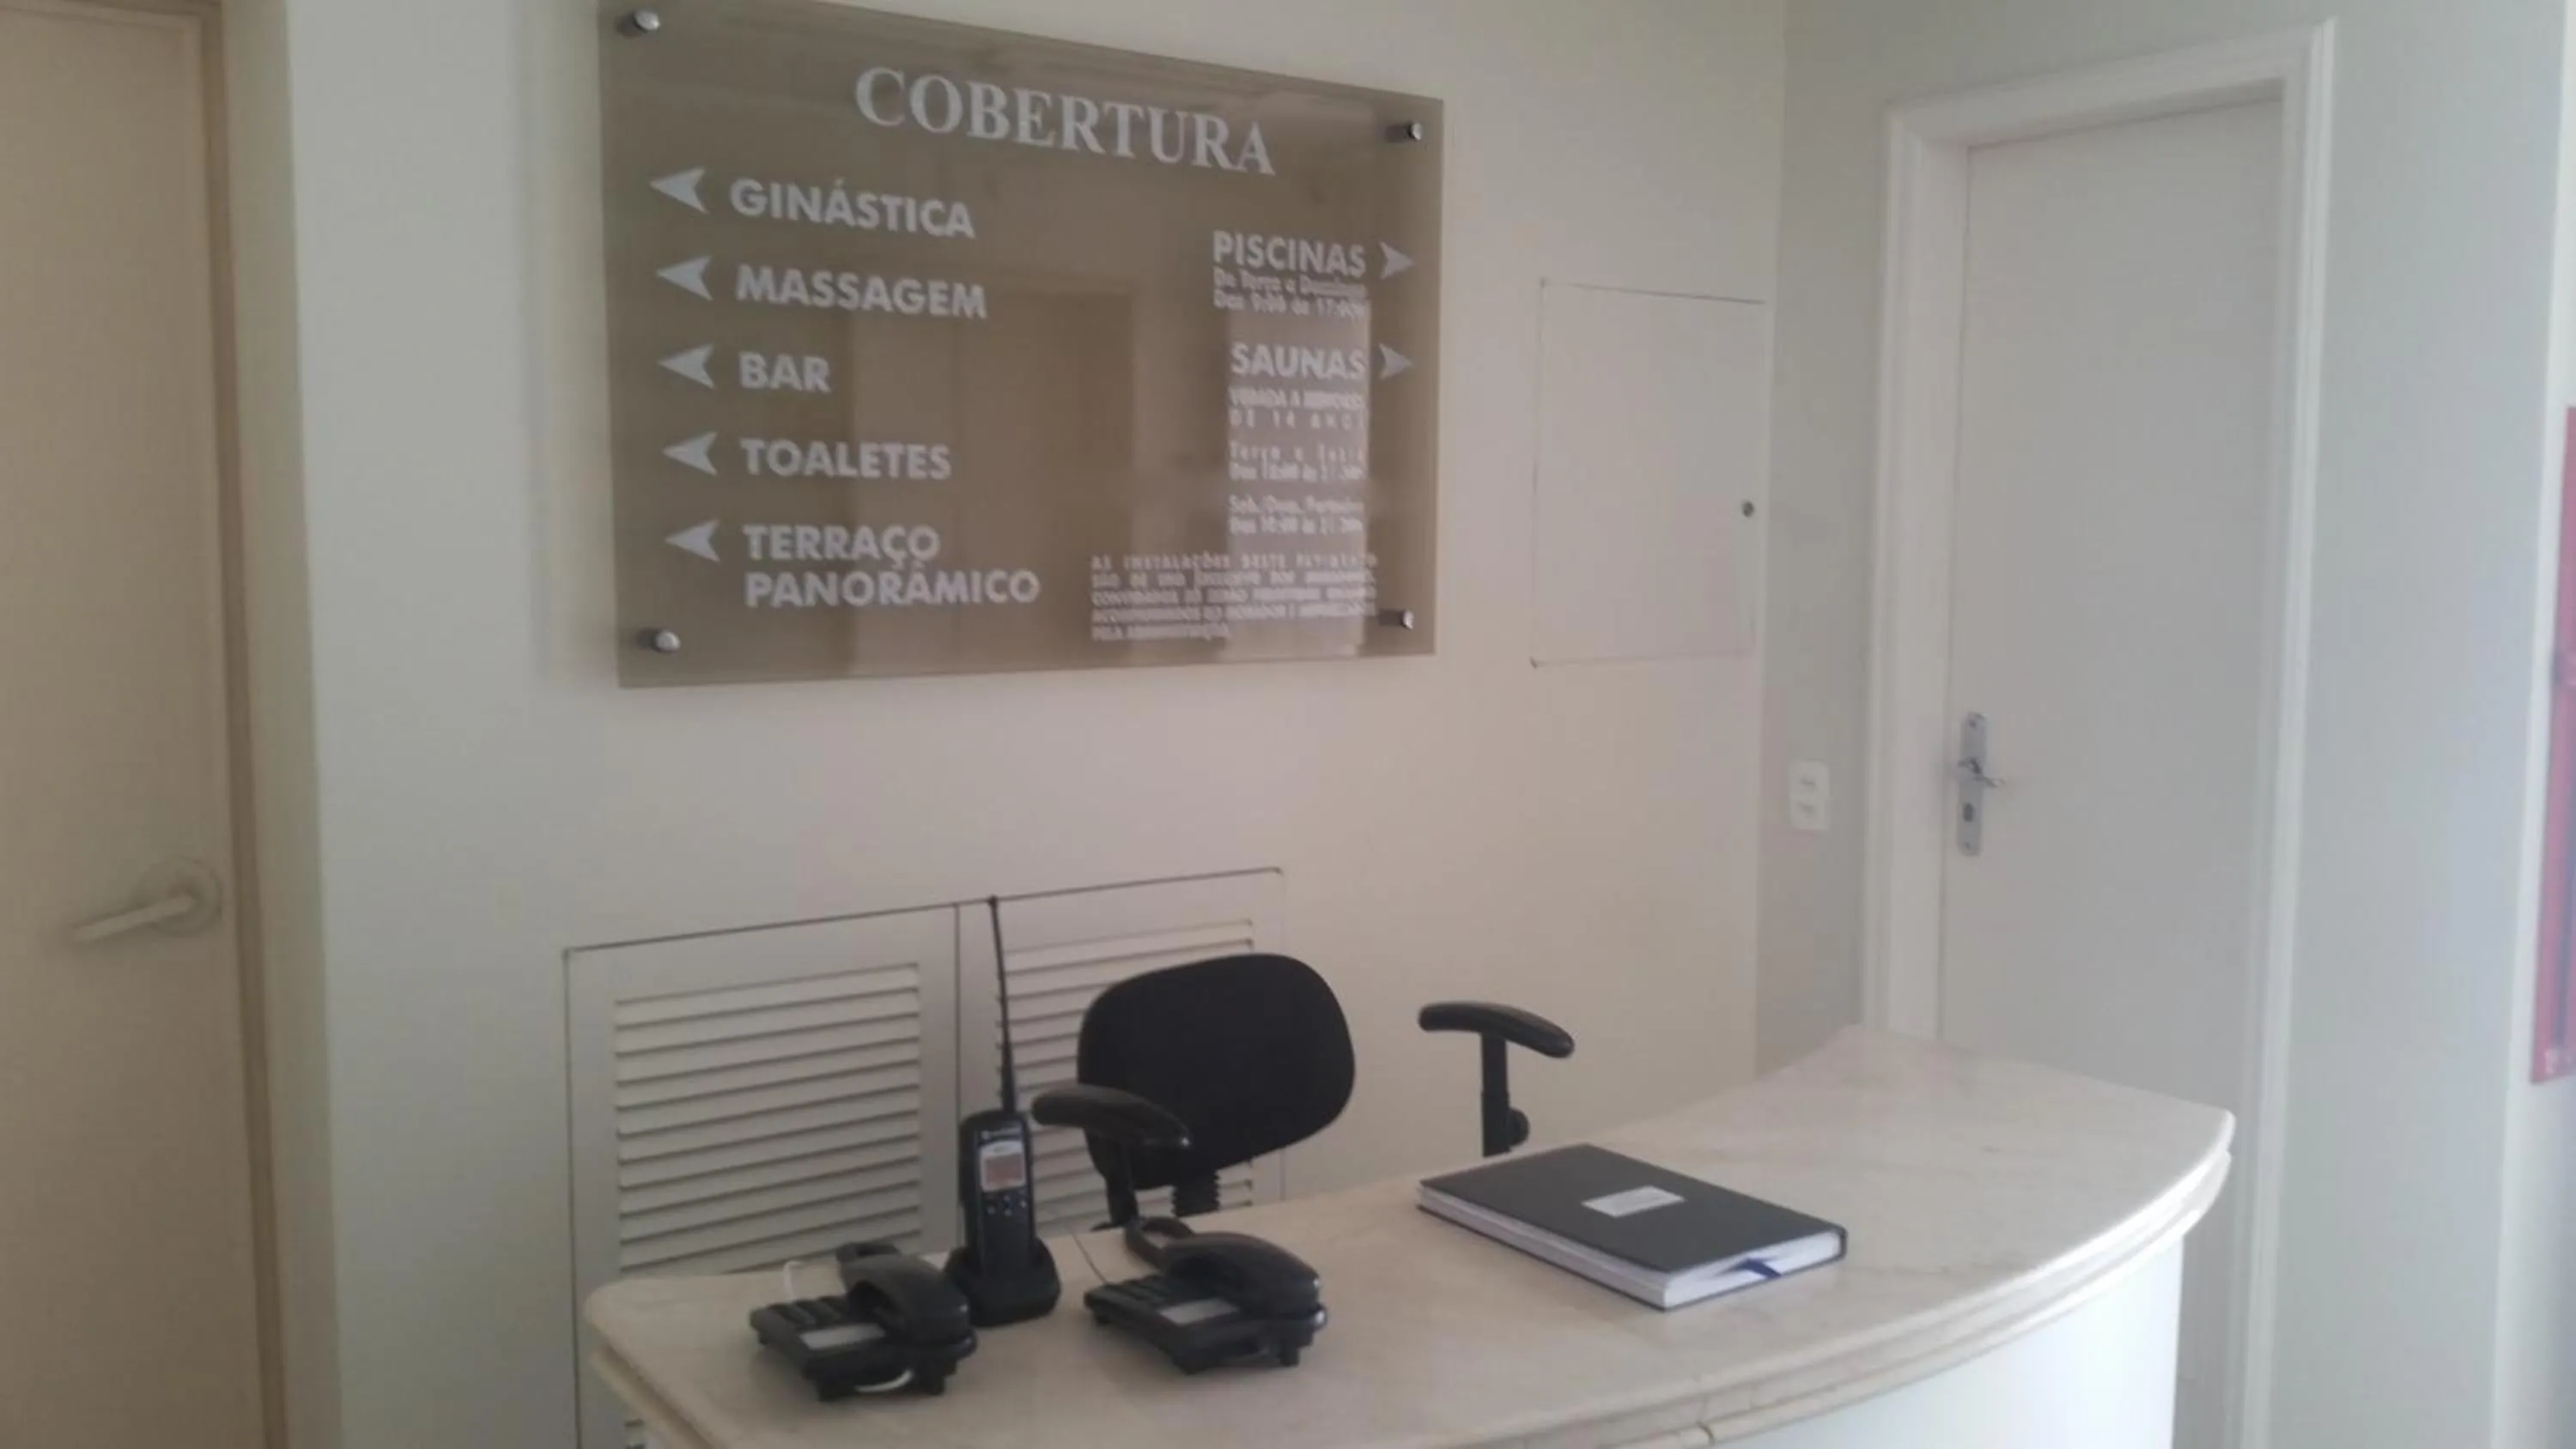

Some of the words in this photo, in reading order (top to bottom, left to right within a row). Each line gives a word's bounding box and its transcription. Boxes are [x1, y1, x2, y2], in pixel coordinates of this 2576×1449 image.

[855, 66, 1277, 177] COBERTURA
[729, 177, 976, 239] GINÁSTICA
[1212, 229, 1367, 278] PISCINAS
[735, 263, 988, 320] MASSAGEM
[738, 350, 831, 395] BAR
[1230, 340, 1367, 380] SAUNAS
[739, 436, 952, 481] TOALETES
[742, 524, 941, 570] TERRAÇO
[744, 560, 1041, 609] PANORÂMICO
